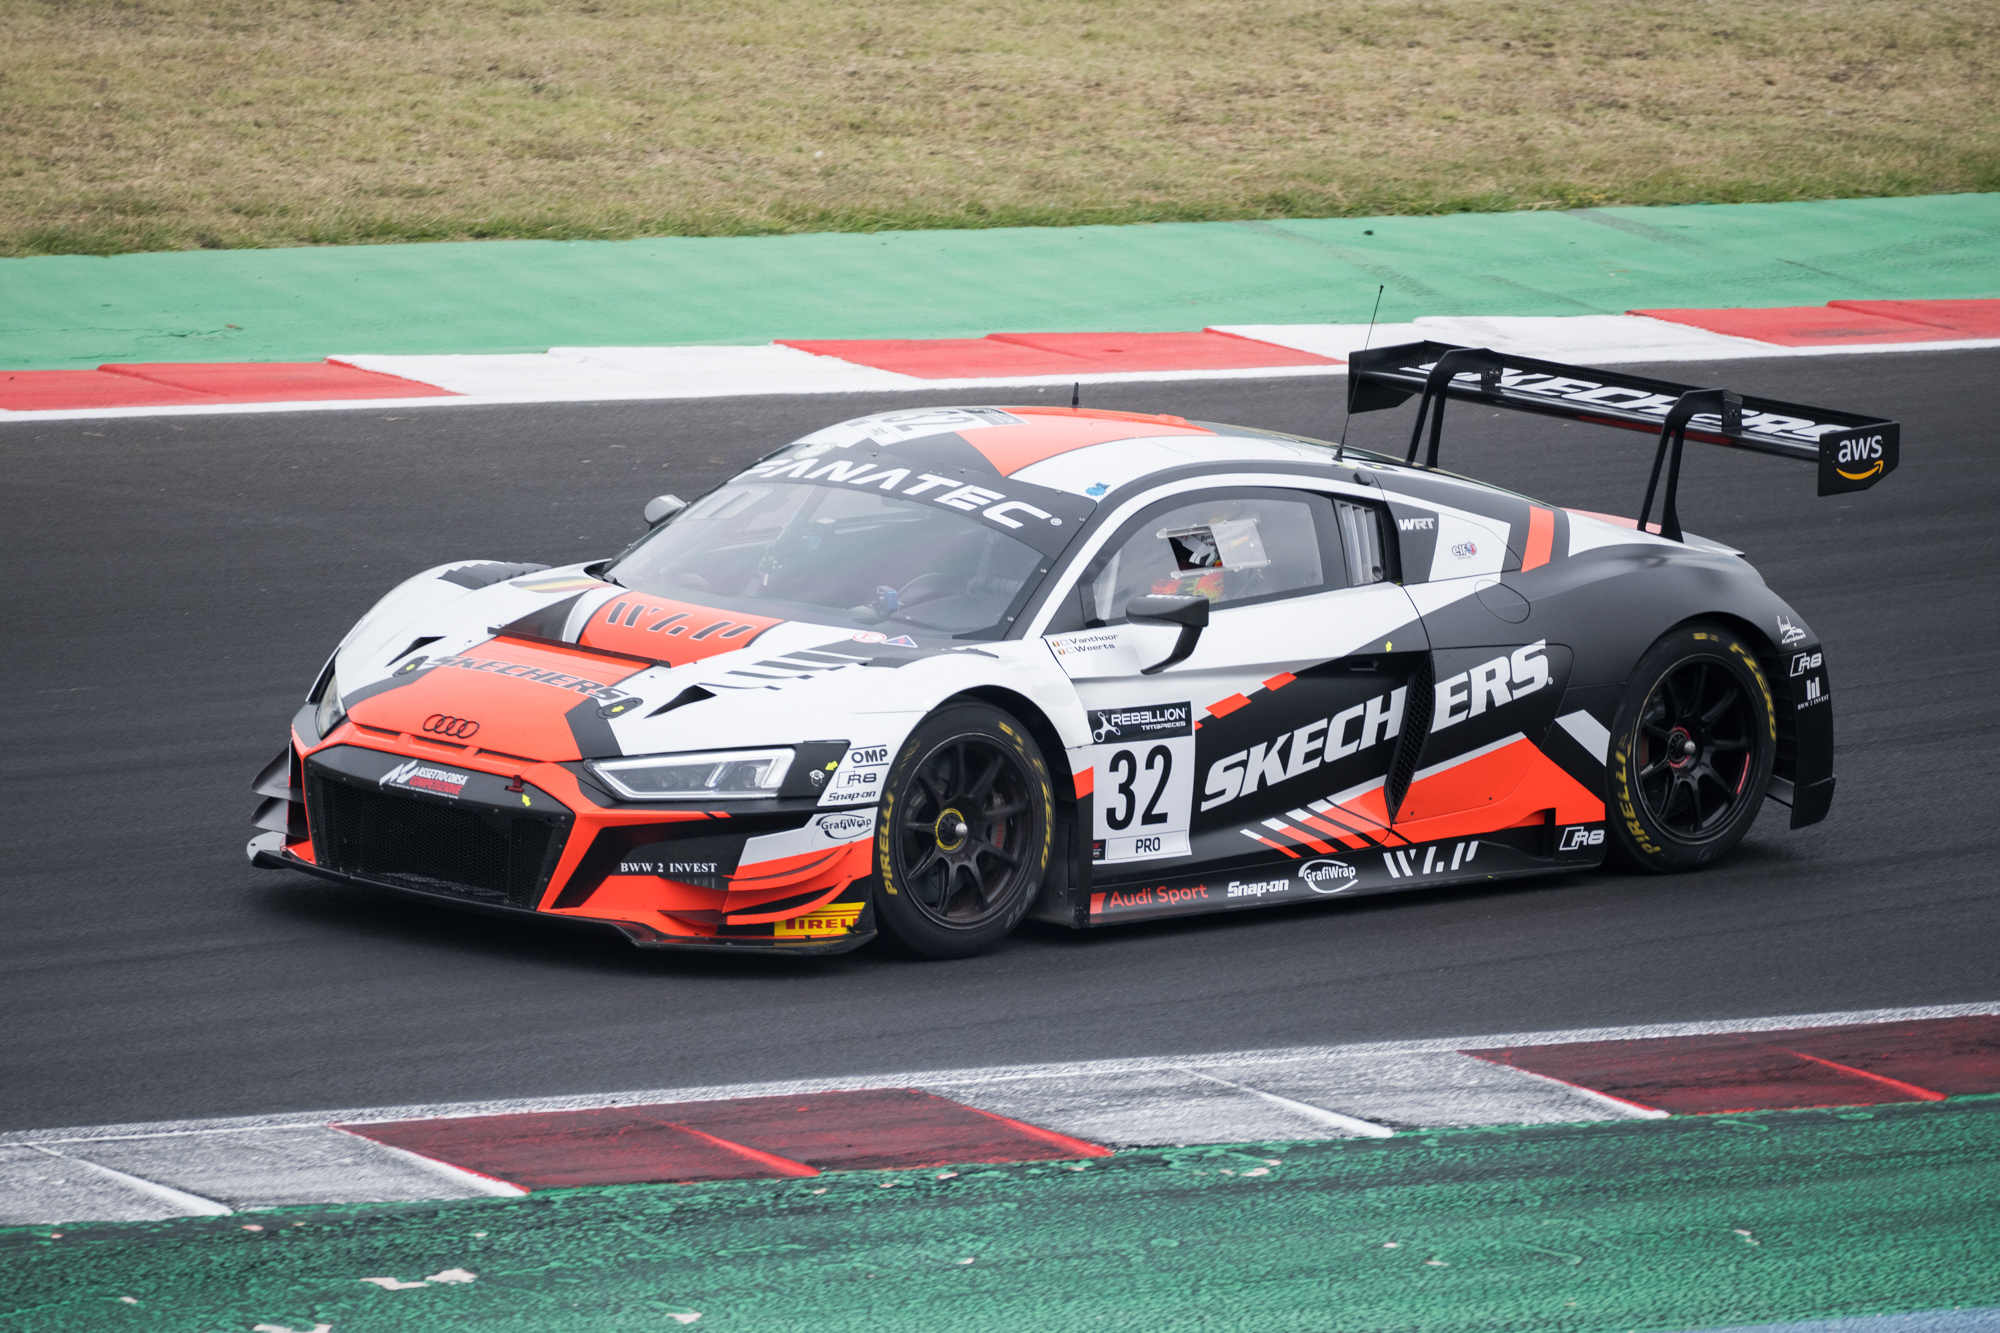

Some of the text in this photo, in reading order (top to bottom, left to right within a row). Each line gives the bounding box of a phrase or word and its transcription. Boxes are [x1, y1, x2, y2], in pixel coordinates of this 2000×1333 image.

[1838, 434, 1883, 463] aws
[727, 458, 1052, 529] FANATEC
[1398, 517, 1435, 531] WRT
[1796, 652, 1822, 672] R8
[425, 655, 630, 701] SKECHERS
[1111, 707, 1186, 726] REBELLION
[1200, 638, 1549, 813] SKECHERS
[851, 749, 888, 764] OMP
[844, 772, 877, 787] R8
[1106, 744, 1172, 831] 32
[827, 790, 877, 802] Snap-on
[1615, 751, 1662, 854] PIRELLI
[820, 817, 872, 831] GrafiWrap
[878, 790, 898, 895] PIRELLI
[1135, 837, 1161, 853] PRO
[1568, 828, 1606, 848] R8
[620, 862, 717, 873] BWW 2 INVEST
[1303, 864, 1356, 882] GrafiWrap
[1109, 883, 1209, 908] Audi Sport
[1227, 879, 1290, 898] Snap-on
